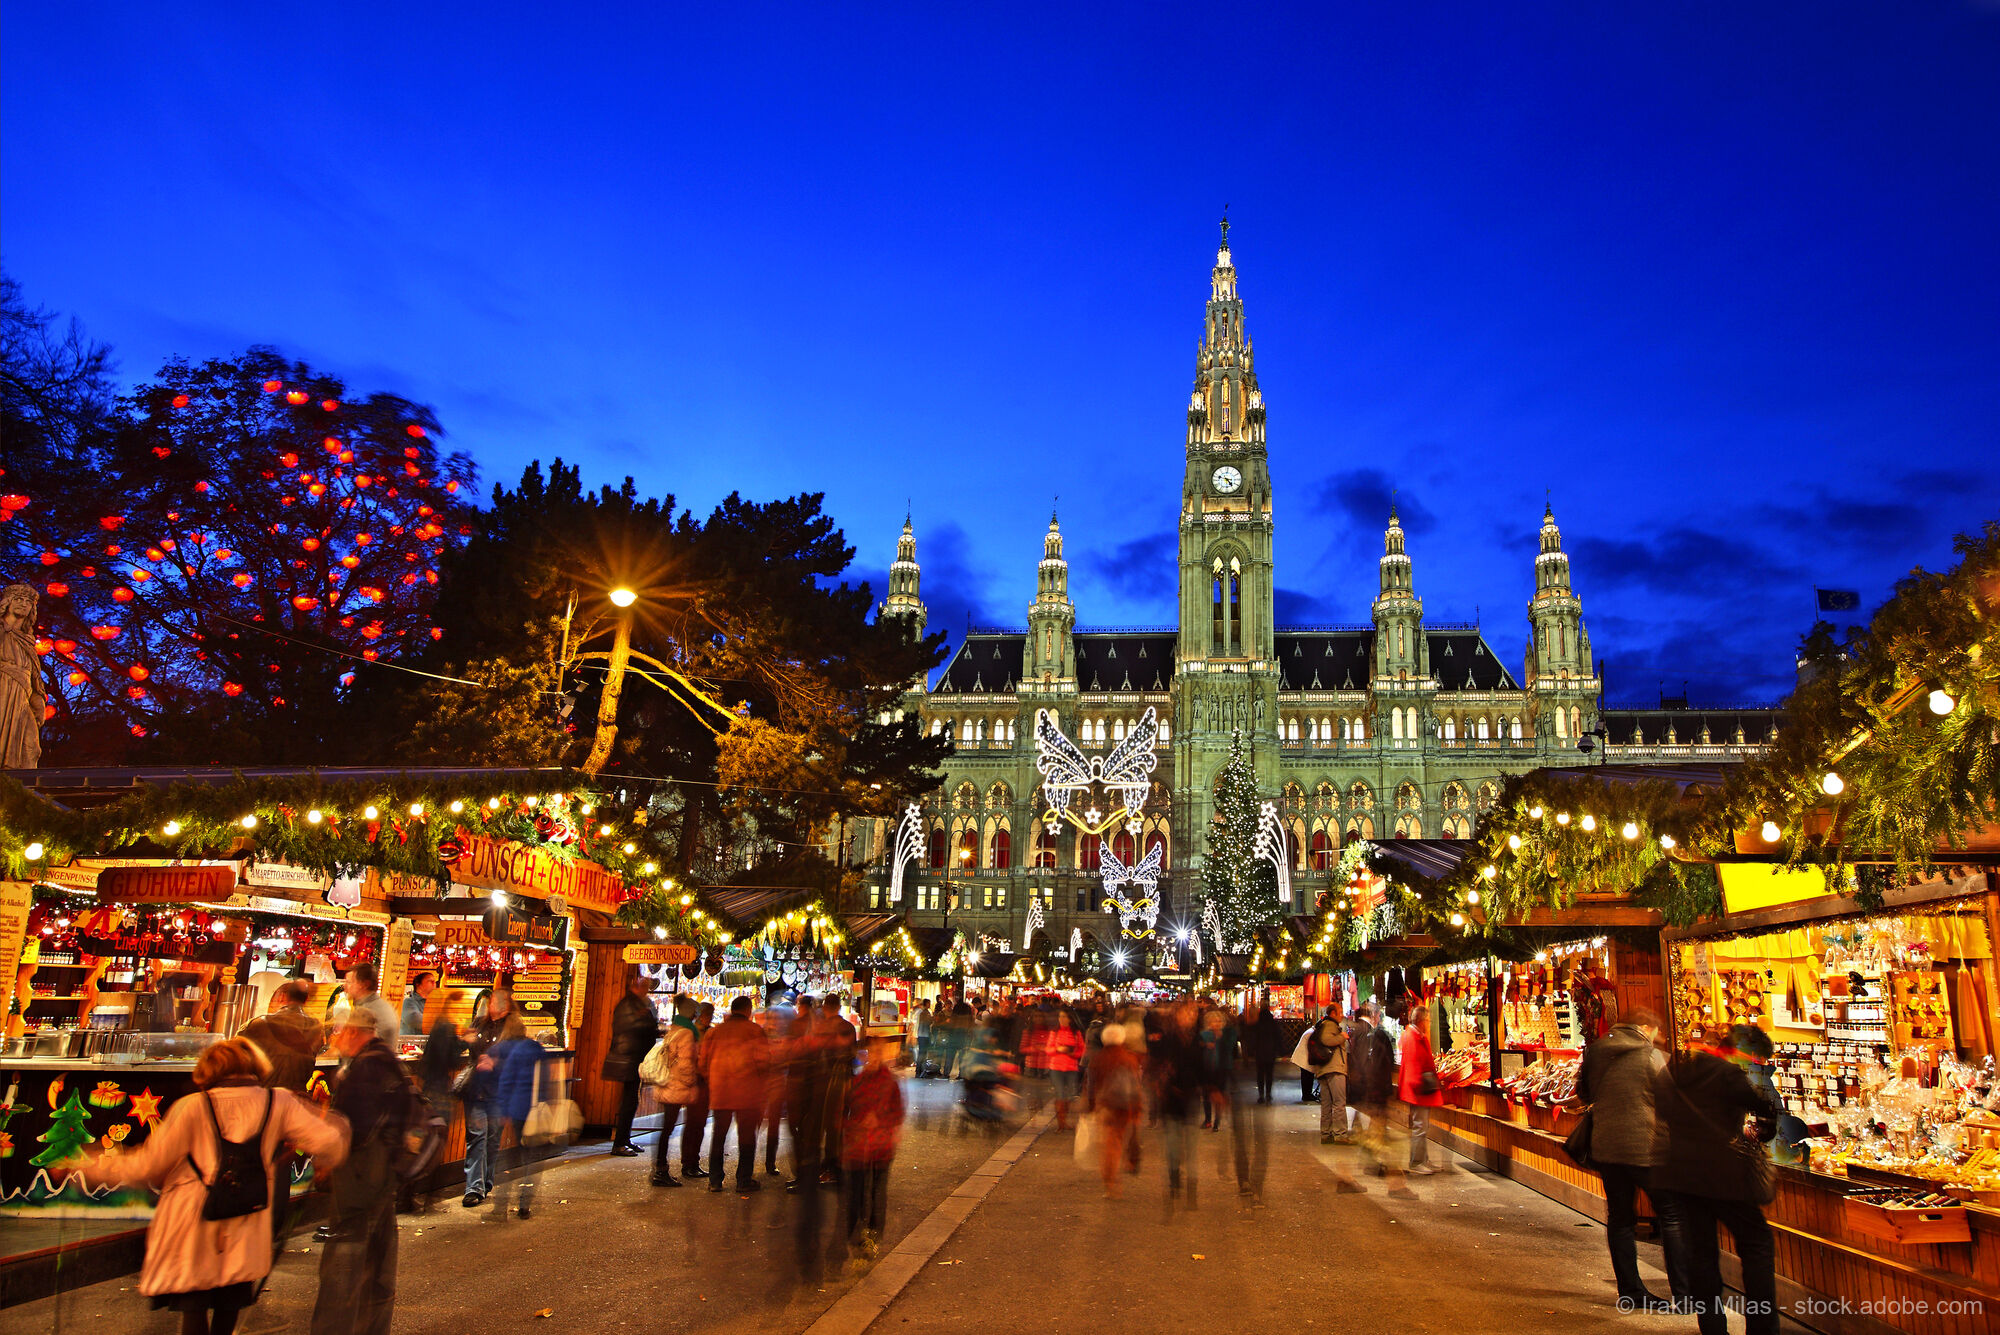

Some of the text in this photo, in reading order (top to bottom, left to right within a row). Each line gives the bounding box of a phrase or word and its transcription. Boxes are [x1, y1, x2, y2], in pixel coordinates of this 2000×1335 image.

[31, 868, 98, 884] ONGENPUNSC
[110, 868, 220, 898] GLÜHWEIN
[548, 858, 623, 905] GLÜHWEIN
[445, 927, 520, 944] PUNS
[507, 913, 527, 942] Energy
[529, 917, 554, 941] Punsch
[155, 938, 194, 956] Punsh
[629, 945, 691, 960] BEERENPUNSCH
